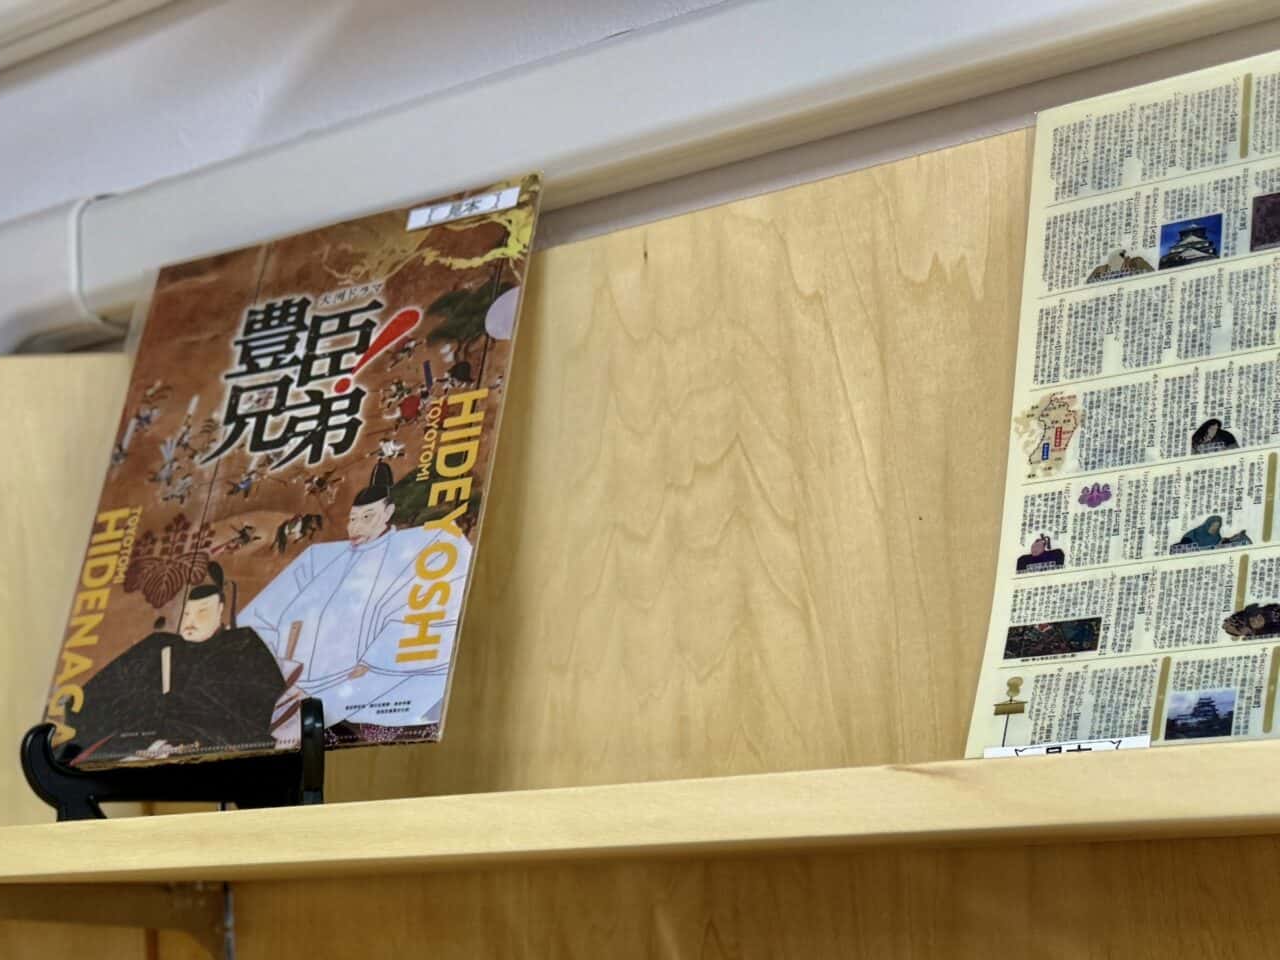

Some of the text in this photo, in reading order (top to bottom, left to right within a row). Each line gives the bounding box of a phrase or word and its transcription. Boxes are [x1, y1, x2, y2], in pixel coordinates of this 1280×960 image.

[415, 395, 448, 482] TOYOTOMI
[112, 505, 144, 584] TOYOTOMI
[395, 387, 489, 664] HIDEYOSHI
